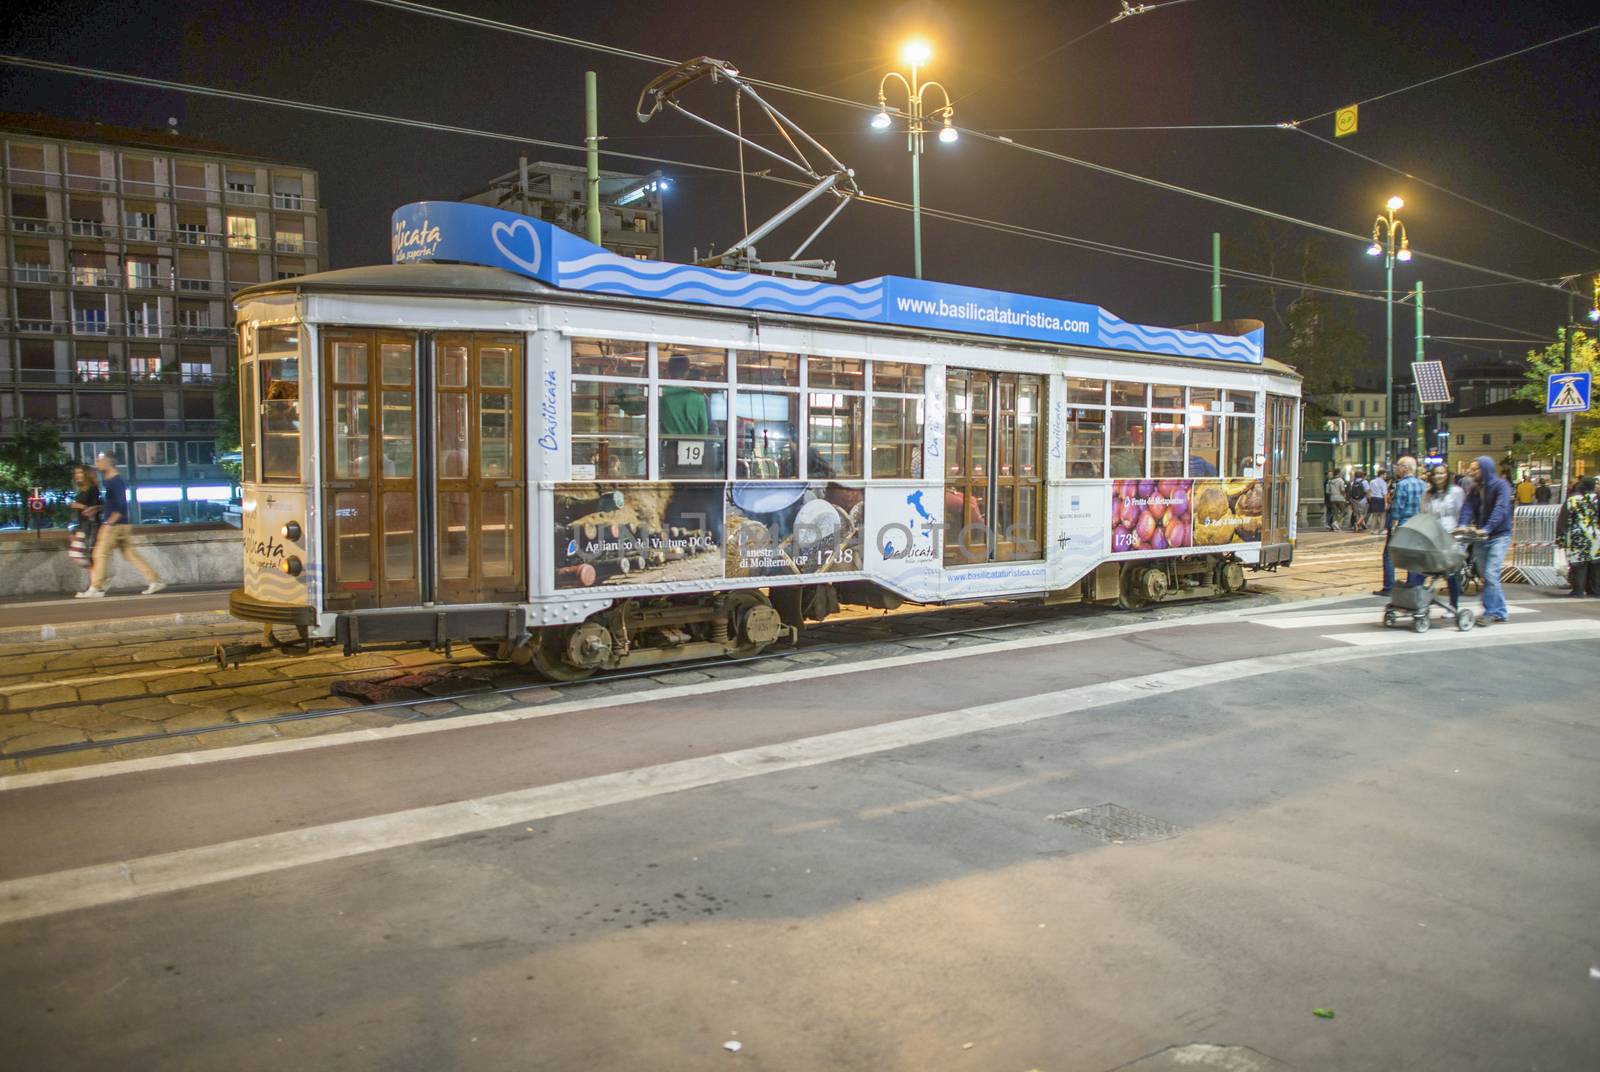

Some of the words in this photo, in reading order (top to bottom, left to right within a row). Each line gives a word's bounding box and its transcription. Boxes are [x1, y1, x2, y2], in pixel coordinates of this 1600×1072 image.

[897, 296, 1090, 334] www.basilicataturistica.com
[538, 370, 558, 451] Basilicata
[684, 447, 701, 461] 19
[1115, 530, 1138, 546] 1738
[740, 558, 749, 569] di
[750, 555, 791, 568] Moliterno
